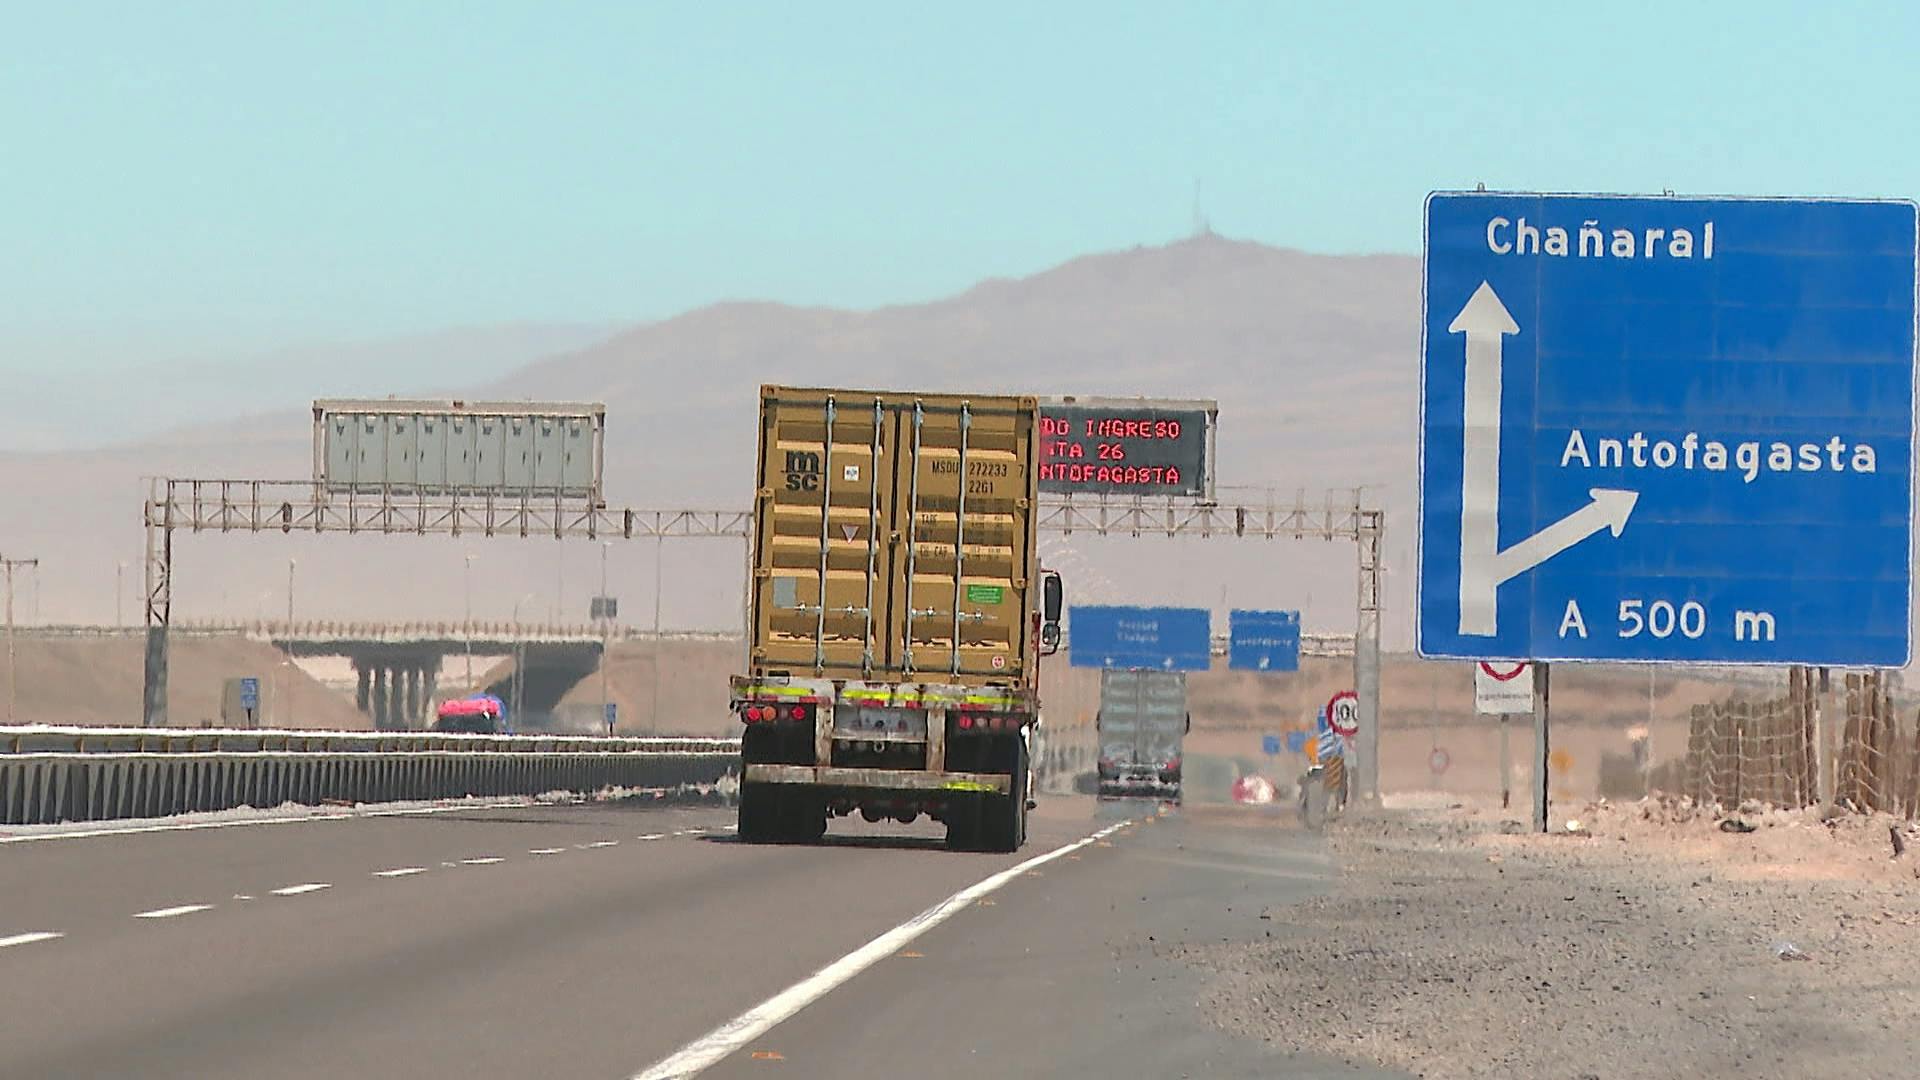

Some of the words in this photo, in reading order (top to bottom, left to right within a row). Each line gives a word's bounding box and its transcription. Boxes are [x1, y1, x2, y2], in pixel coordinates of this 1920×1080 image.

[1487, 217, 1714, 259] Chañaral
[1087, 419, 1180, 438] INGRESO
[1098, 444, 1123, 460] 26
[1561, 429, 1876, 483] Antofagasta
[969, 463, 1007, 477] 272233
[1559, 600, 1588, 638] A
[1618, 601, 1706, 639] 500
[1735, 609, 1775, 641] m
